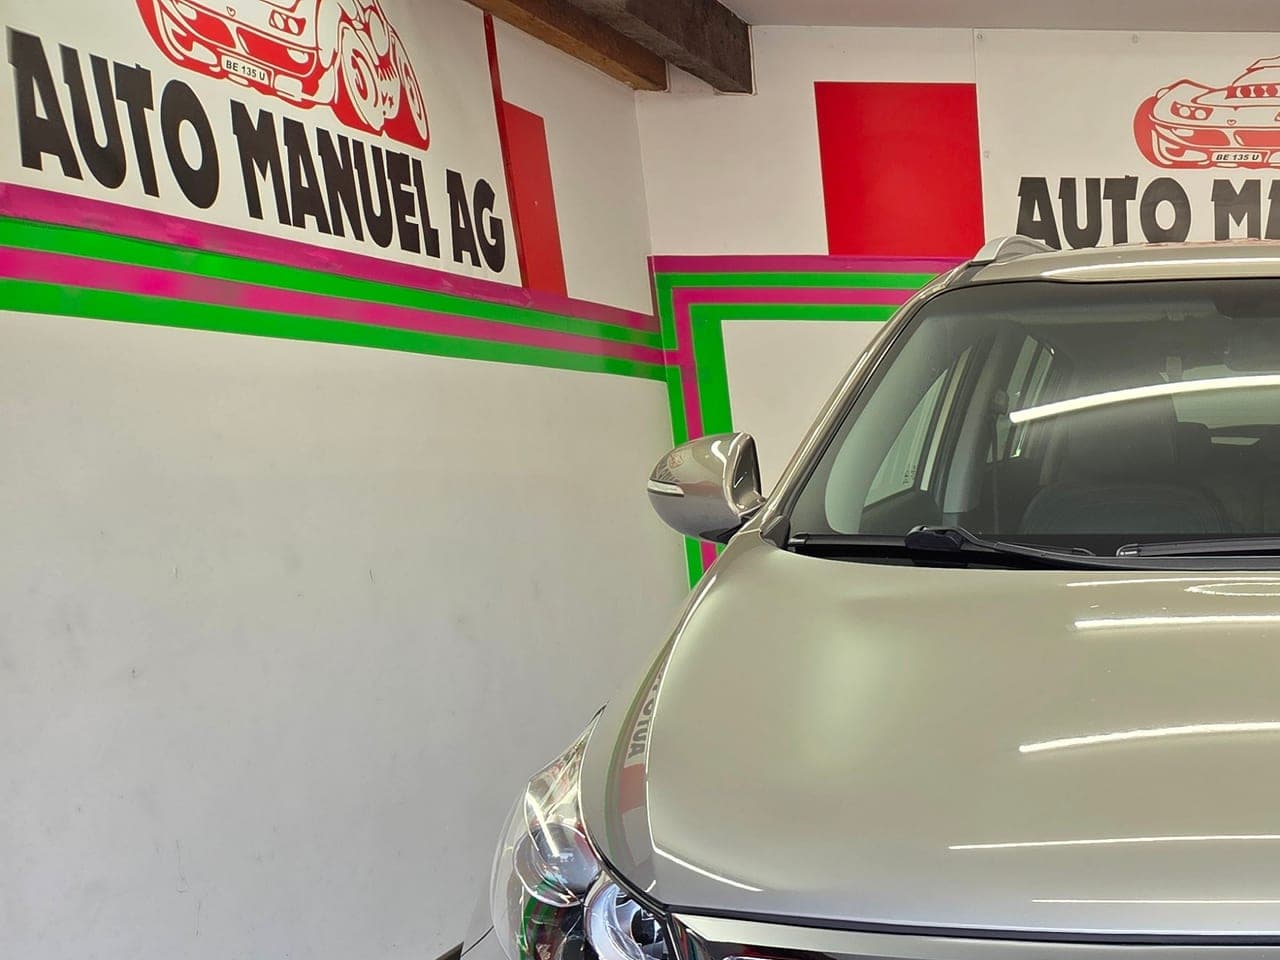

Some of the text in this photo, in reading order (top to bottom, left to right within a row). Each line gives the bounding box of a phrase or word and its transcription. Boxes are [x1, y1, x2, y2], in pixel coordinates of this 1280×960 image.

[225, 59, 266, 81] BE 135 U
[6, 25, 506, 273] AUTO MANUEL AG
[1233, 153, 1250, 161] 135
[1016, 174, 1192, 250] AUTO
